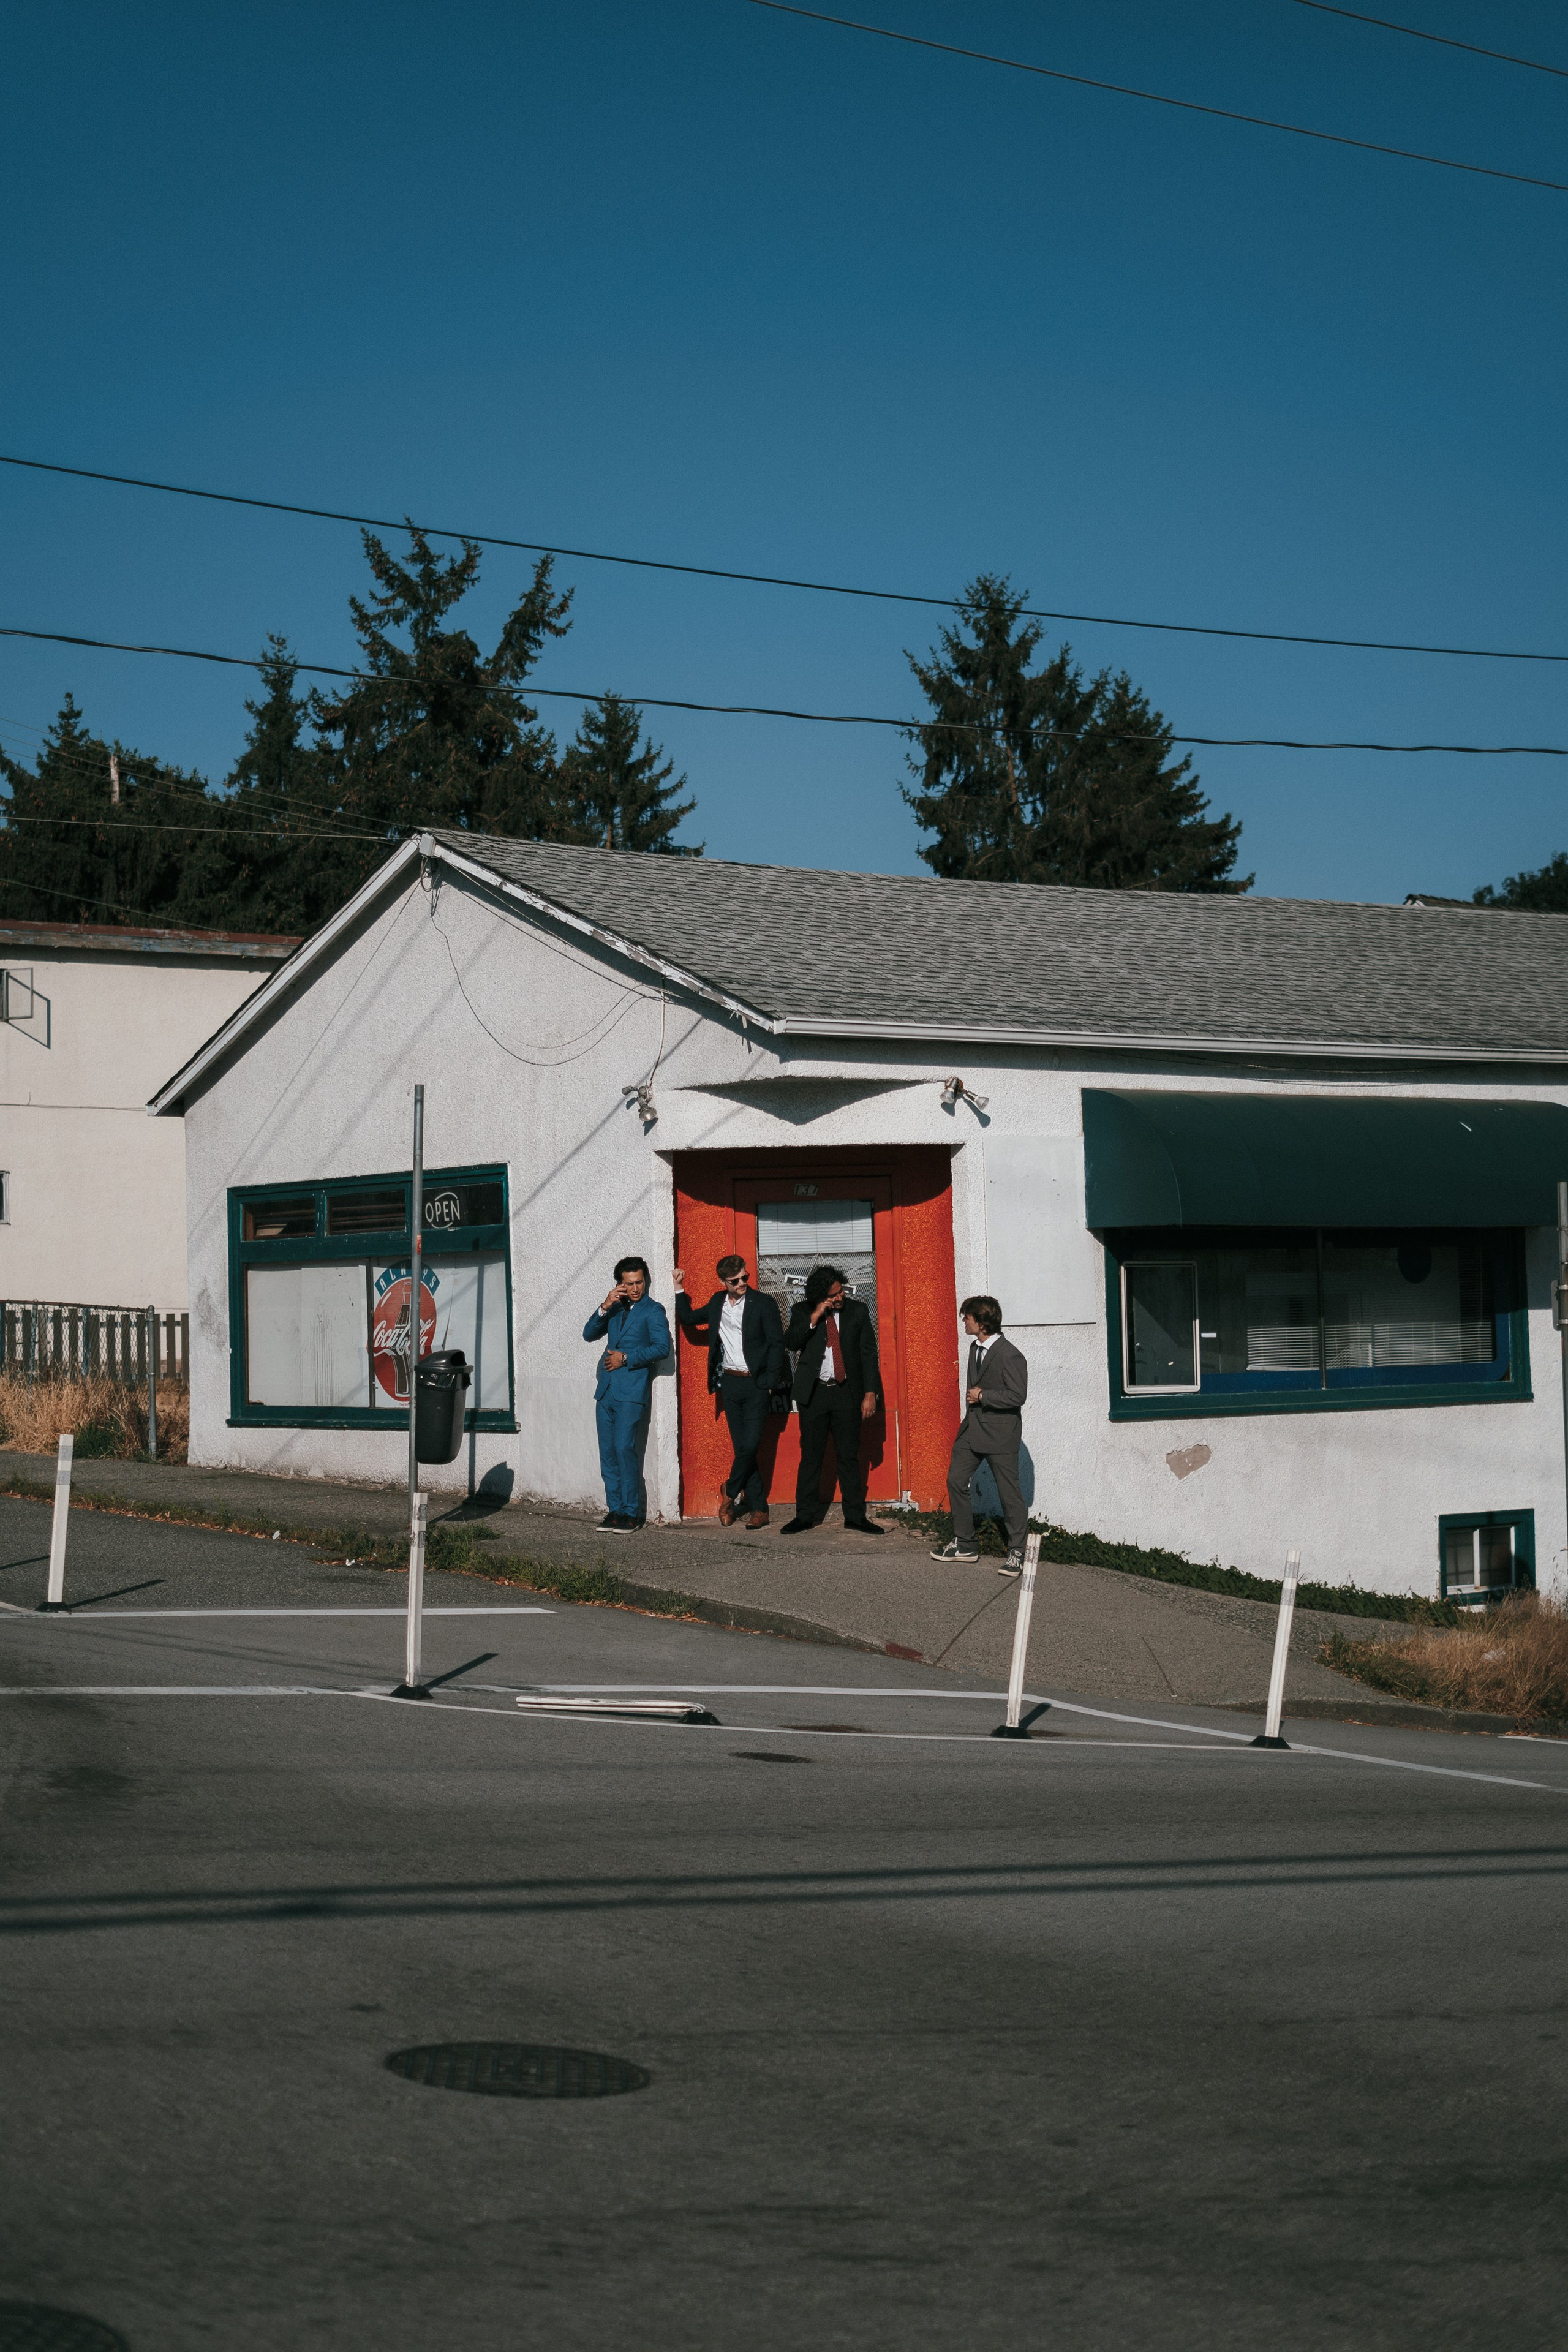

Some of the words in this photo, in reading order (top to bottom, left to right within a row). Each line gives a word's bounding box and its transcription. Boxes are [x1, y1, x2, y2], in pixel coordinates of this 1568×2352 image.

[795, 1184, 818, 1195] 137
[425, 1200, 461, 1223] OPEN
[379, 1261, 437, 1291] ALWYS
